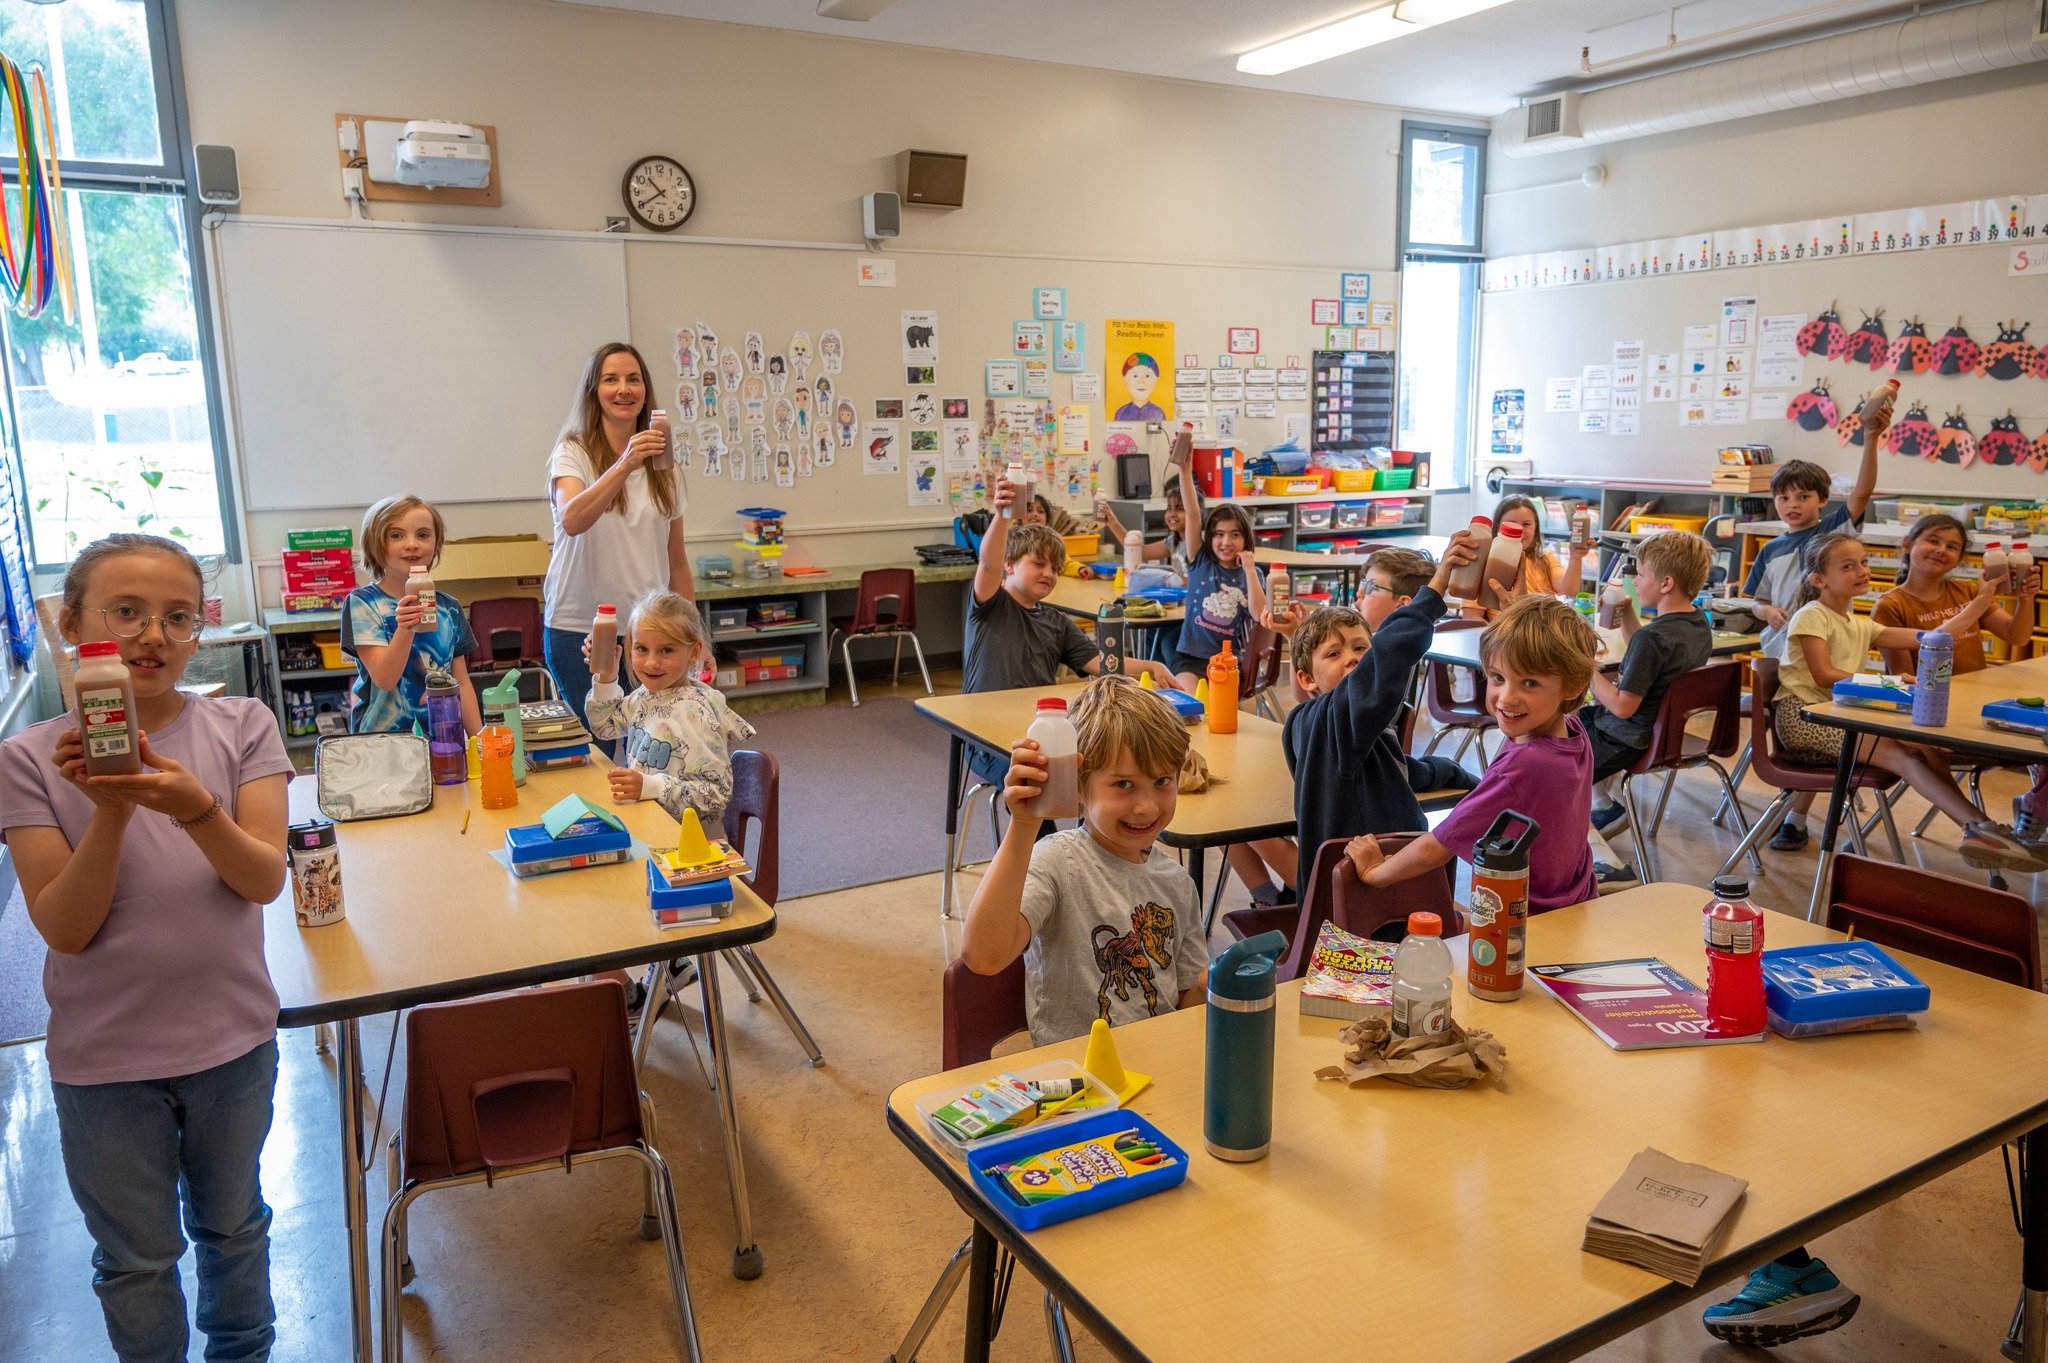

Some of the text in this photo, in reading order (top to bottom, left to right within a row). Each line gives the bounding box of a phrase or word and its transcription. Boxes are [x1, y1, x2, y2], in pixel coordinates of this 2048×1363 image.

[644, 166, 652, 175] 11
[655, 164, 664, 174] 12
[668, 168, 672, 177] 1
[636, 175, 645, 185] 10
[676, 177, 683, 186] 2
[633, 187, 640, 196] 9
[681, 191, 686, 200] 3
[638, 200, 645, 209] 8
[677, 204, 684, 212] 4
[647, 210, 653, 219] 7
[658, 214, 664, 223] 6
[669, 212, 675, 220] 5
[1608, 270, 1613, 278] 12
[1619, 269, 1624, 277] 13
[1642, 266, 1647, 275] 15
[1653, 265, 1658, 273] 16
[1665, 263, 1671, 272] 17
[1678, 262, 1683, 270] 18
[1689, 260, 1695, 269] 19
[1700, 259, 1708, 268] 20
[1715, 257, 1721, 266] 21
[1727, 256, 1735, 265] 22
[1741, 254, 1748, 264] 23
[1754, 253, 1762, 262] 24
[1768, 251, 1776, 261] 25
[1781, 250, 1789, 260] 26
[1795, 248, 1804, 258] 27
[1810, 248, 1818, 257] 28
[1824, 246, 1833, 255] 29
[1839, 244, 1848, 254] 30
[1856, 242, 1864, 252] 31
[1871, 240, 1880, 250] 32
[1886, 239, 1895, 249] 33
[1901, 238, 1912, 248] 34
[1919, 236, 1929, 246] 35
[1936, 235, 1946, 245] 36
[1953, 233, 1963, 243] 37
[1969, 231, 1980, 242] 38
[1988, 229, 1998, 240] 39
[2005, 227, 2018, 238] 40
[2023, 226, 2034, 237] 41
[1117, 330, 1142, 339] Reading
[1917, 610, 1940, 622] WILD
[87, 699, 120, 707] APPLE
[1473, 971, 1493, 984] YETI
[1605, 1008, 1697, 1018] Notebook/Cahier
[1655, 1020, 1720, 1035] 200
[1063, 1150, 1097, 1176] CRAYONS
[1080, 1148, 1111, 1175] PENCILS
[1087, 1143, 1127, 1177] COLOURED
[1055, 1156, 1087, 1184] COULEUR
[1024, 1171, 1048, 1185] 24
